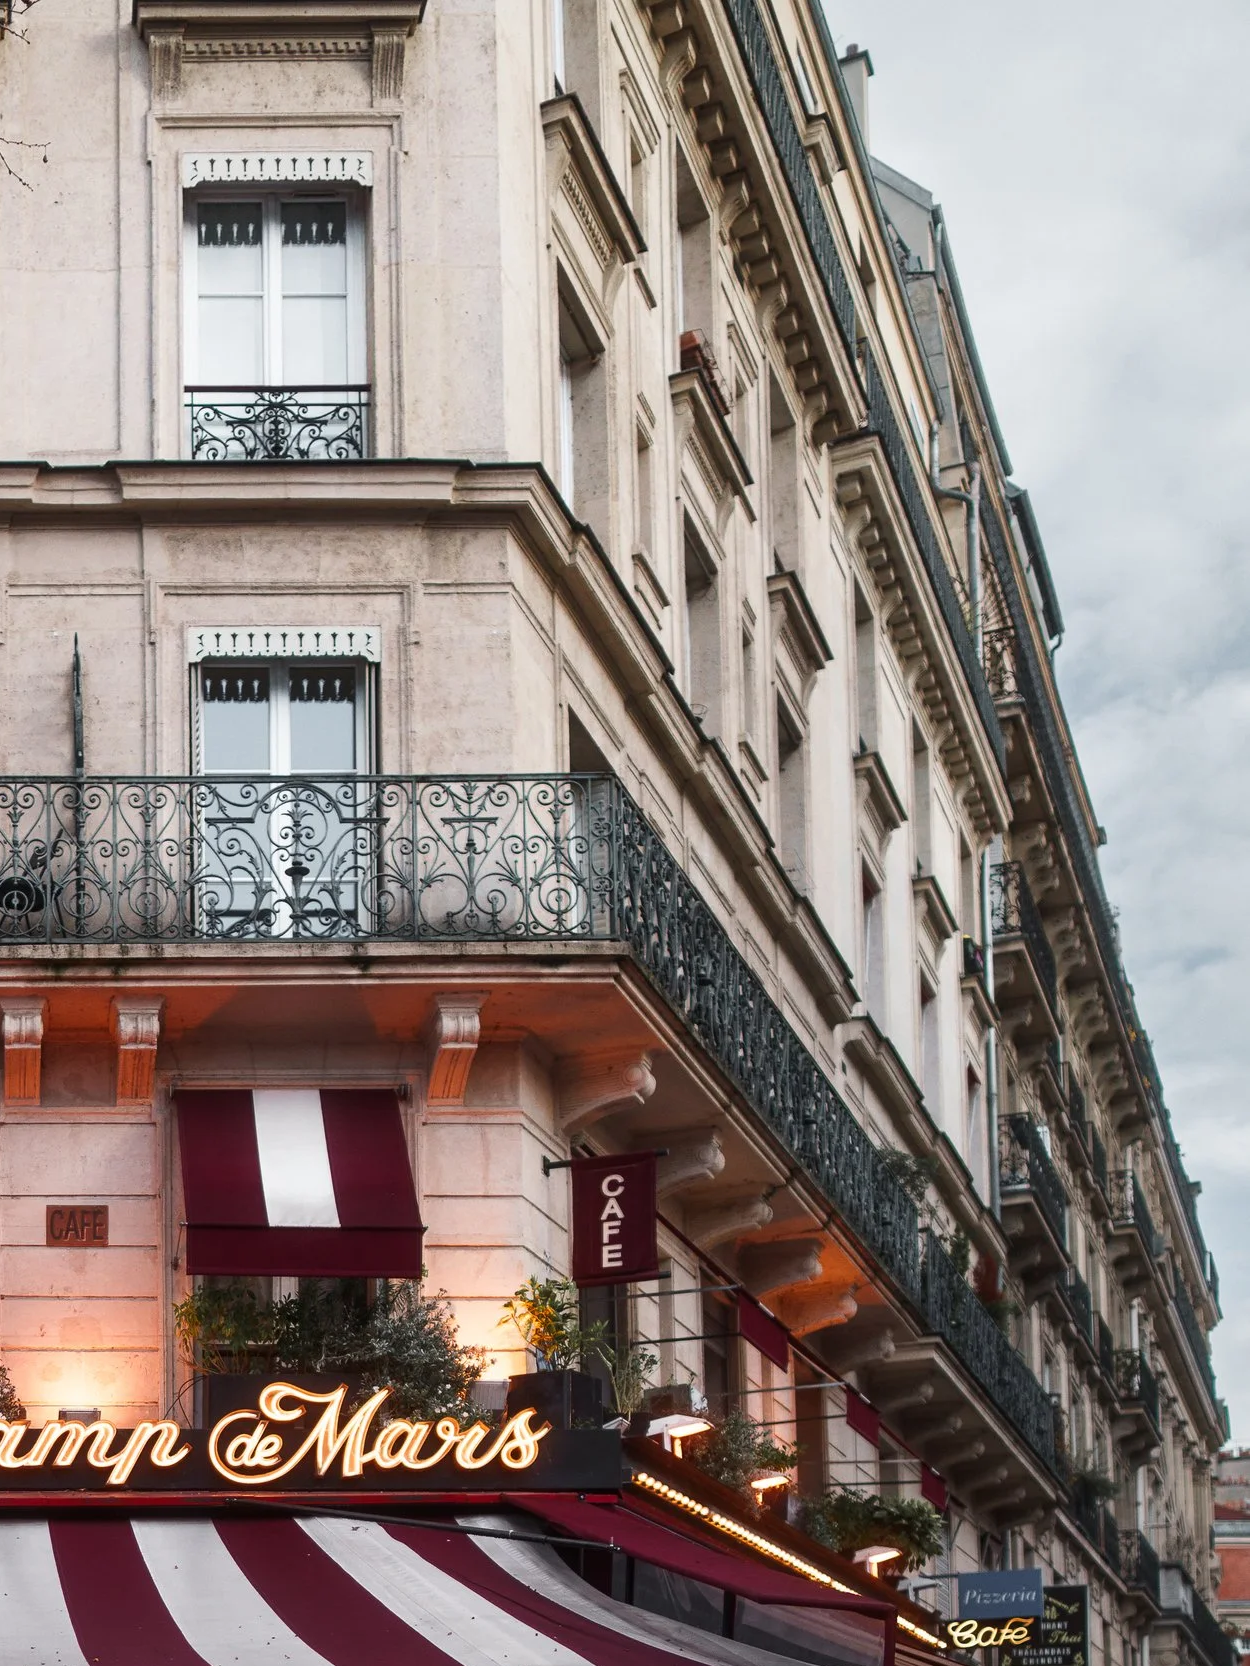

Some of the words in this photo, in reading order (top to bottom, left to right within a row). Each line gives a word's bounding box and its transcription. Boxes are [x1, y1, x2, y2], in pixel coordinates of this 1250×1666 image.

[50, 1209, 106, 1242] CAFE
[600, 1173, 625, 1268] CAFE
[208, 1381, 553, 1484] Mars
[223, 1419, 283, 1467] de
[964, 1586, 1037, 1605] Pizzeria
